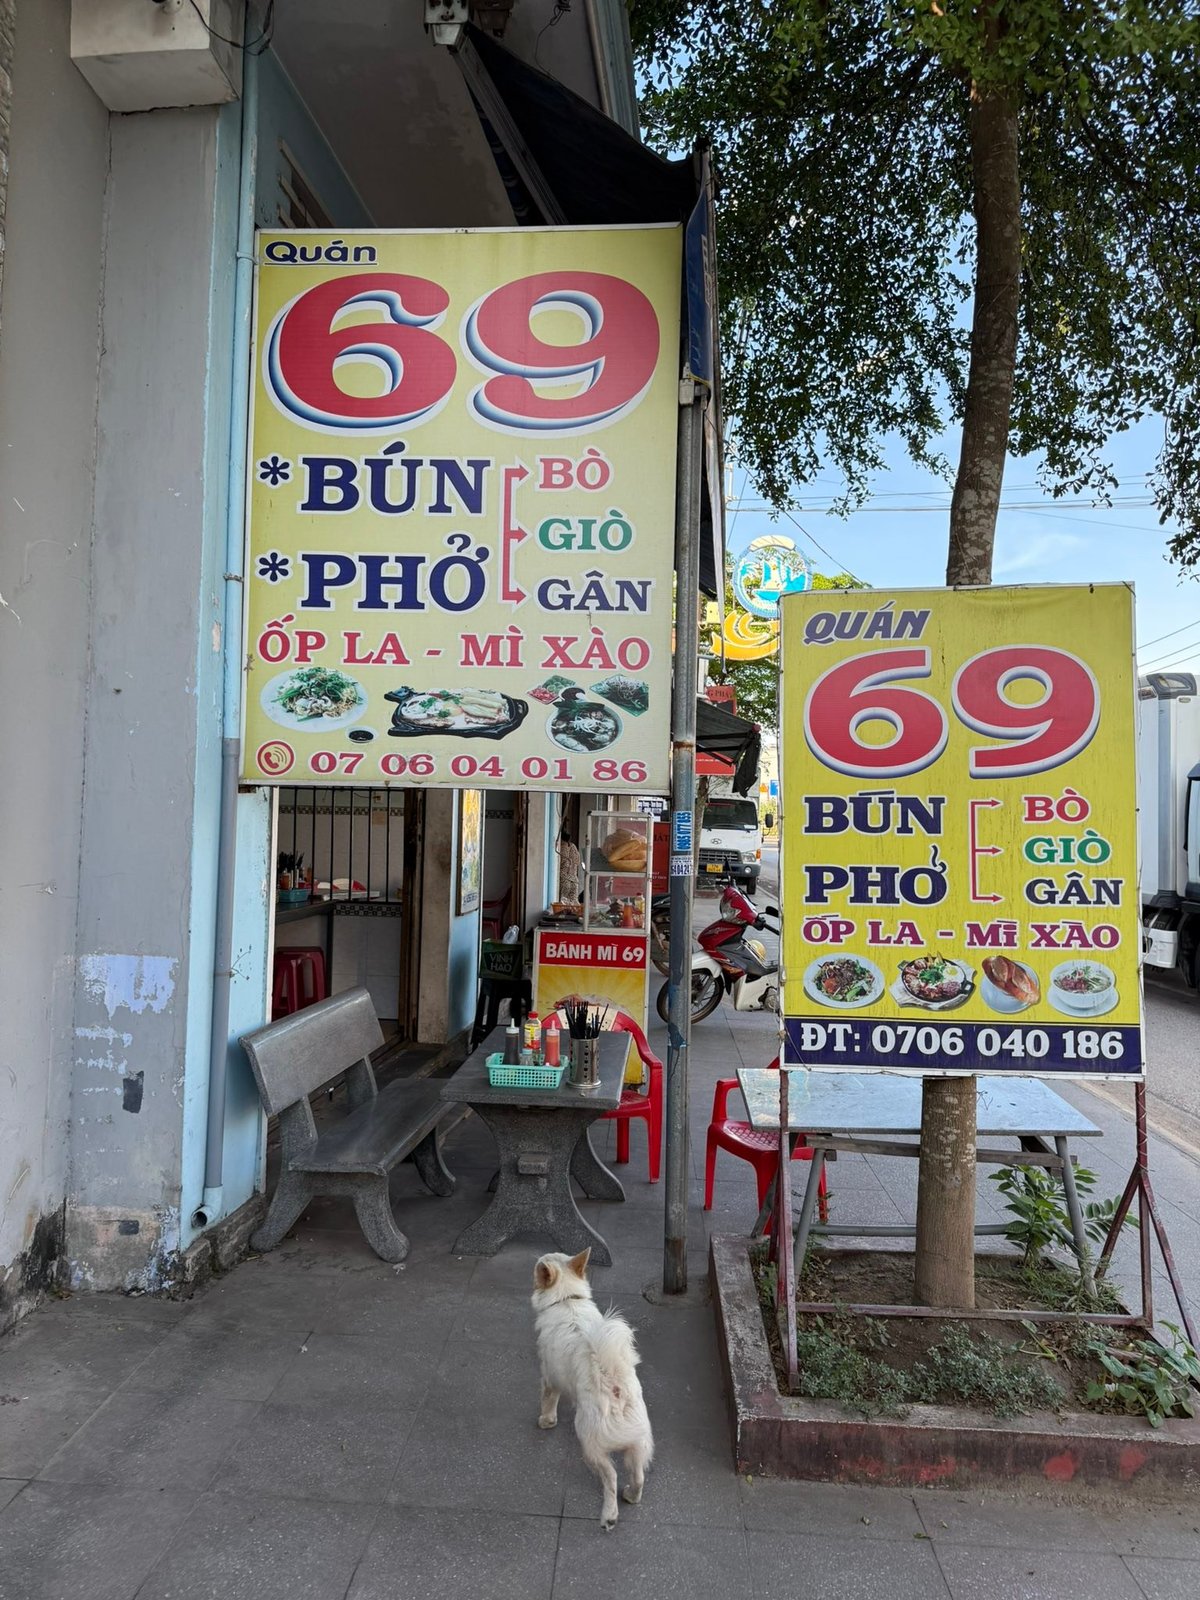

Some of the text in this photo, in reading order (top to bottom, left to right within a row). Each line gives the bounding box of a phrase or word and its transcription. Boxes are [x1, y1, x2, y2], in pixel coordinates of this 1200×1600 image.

[264, 241, 377, 263] Quán
[266, 271, 660, 432] 69
[302, 441, 610, 514] BÚN BÒ
[538, 508, 633, 550] GIÒ
[301, 534, 652, 612] PHỞ GÂN
[259, 615, 326, 662] ỐP
[343, 632, 410, 665] LA
[460, 626, 524, 667] MÌ
[542, 627, 650, 671] XÀO
[804, 601, 930, 645] QUÁN
[805, 645, 1099, 778] 69
[311, 752, 647, 782] 07 06 04 01 86
[804, 789, 1089, 833] BÚN BÒ
[1024, 830, 1110, 863] GIÒ
[805, 845, 1122, 905] PHỞ GÂN
[546, 941, 645, 962] BÁNH MÌ 69
[868, 921, 924, 945] LA
[1031, 921, 1120, 948] XÀO
[801, 1023, 1124, 1059] ĐT: 0706 040 186
